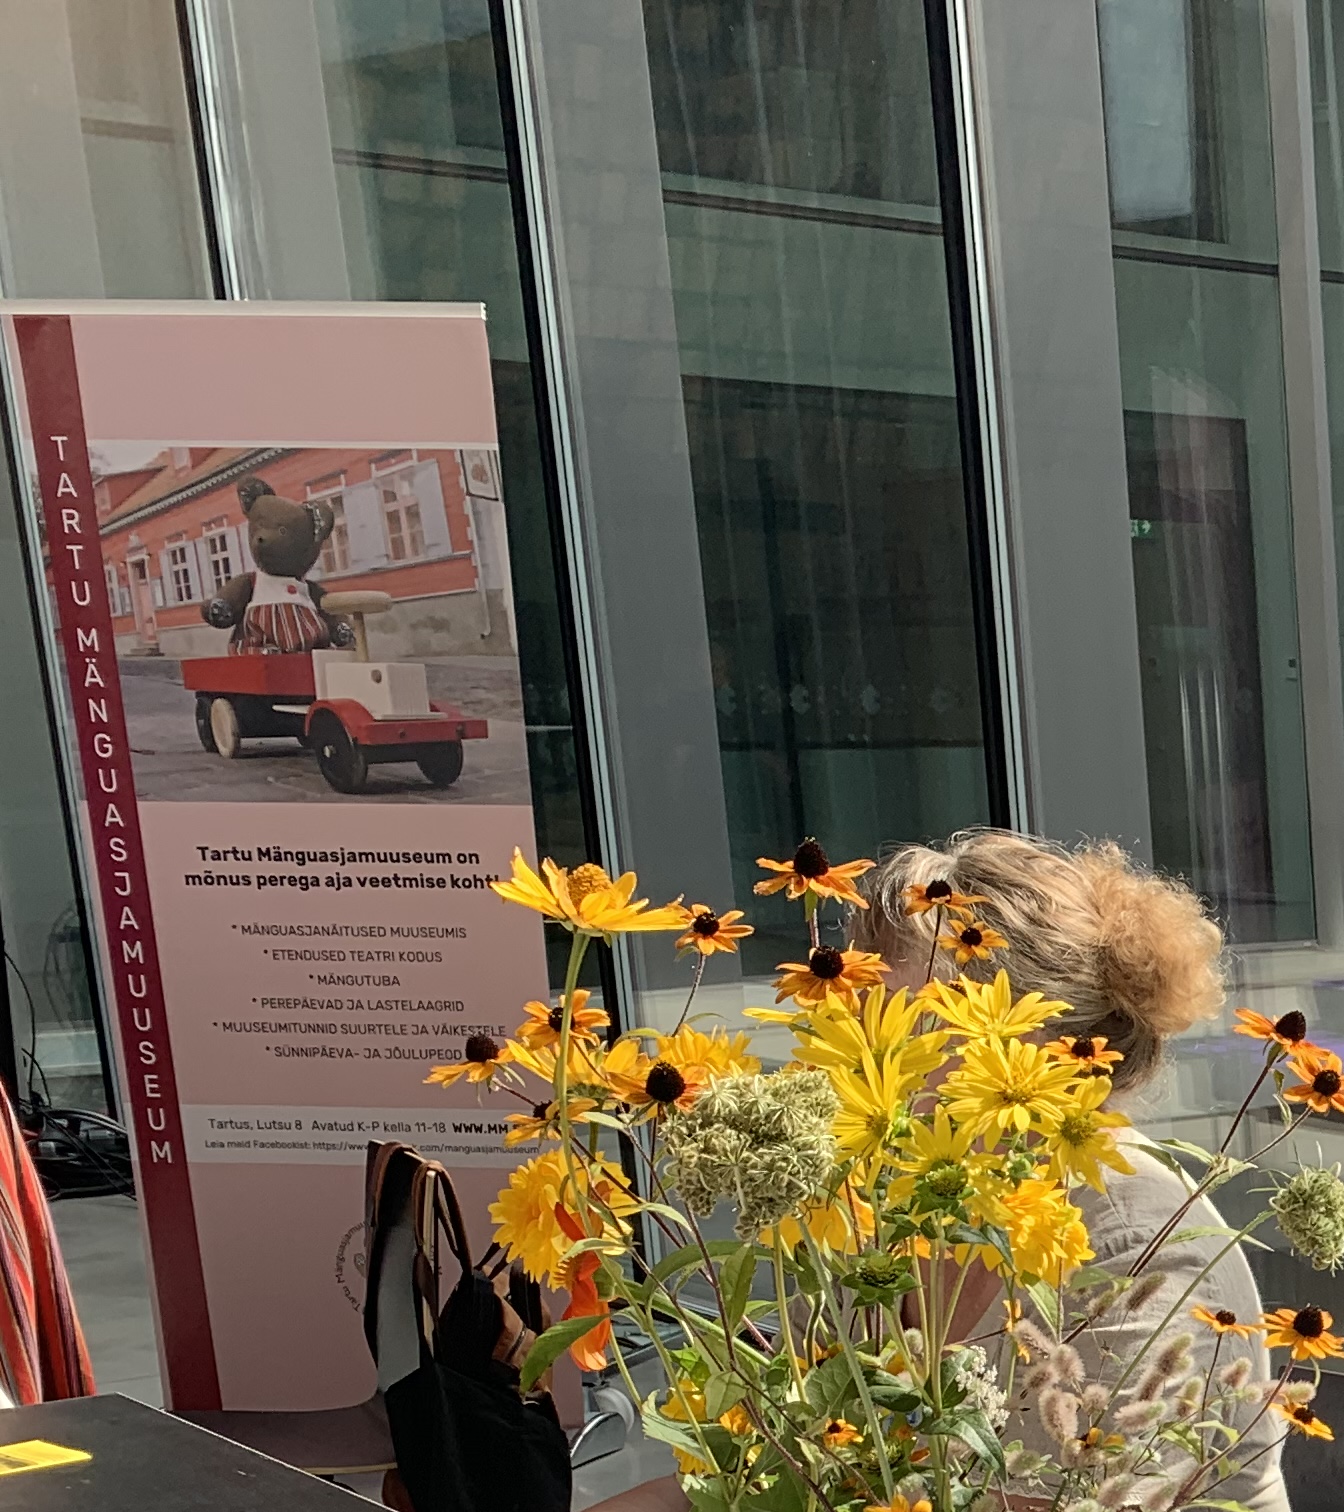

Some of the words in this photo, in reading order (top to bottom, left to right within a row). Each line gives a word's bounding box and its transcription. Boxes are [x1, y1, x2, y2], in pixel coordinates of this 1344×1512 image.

[50, 435, 92, 607] TARTU
[76, 628, 174, 1165] MÄNGUASJAMUUSEUM
[196, 846, 252, 863] Tartu
[256, 846, 453, 867] Mänguasjamuuseum
[456, 852, 480, 865] on
[184, 870, 252, 887] mõnus
[256, 875, 321, 892] perega
[324, 872, 353, 891] aja
[356, 872, 447, 890] veetmise
[241, 923, 387, 939] MÄNGUASJANÄITUSED
[390, 926, 468, 940] MUUSEUMIS
[272, 949, 346, 963] ETENDUSED
[349, 949, 396, 963] TEATRI
[398, 950, 443, 964] KODUS
[317, 973, 401, 988] MÄNGUTUBA
[260, 996, 344, 1012] PEREPÄEVAD
[346, 997, 366, 1012] JA
[367, 998, 465, 1013] LASTELAAGRID
[222, 1020, 338, 1036] MUUSEUMITUNNID
[340, 1023, 408, 1037] SUURTELE
[411, 1023, 430, 1038] JA
[274, 1045, 360, 1060] SÜNNIPÄEVA-
[363, 1047, 382, 1061] JA
[384, 1046, 463, 1062] JÕULUPEOD
[208, 1118, 253, 1132] Tartus,
[257, 1119, 292, 1132] Lutsu
[294, 1119, 302, 1131] 8
[311, 1119, 354, 1133] Avatud
[358, 1120, 380, 1133] K-P
[383, 1121, 411, 1134] kella
[415, 1121, 447, 1134] 11-18
